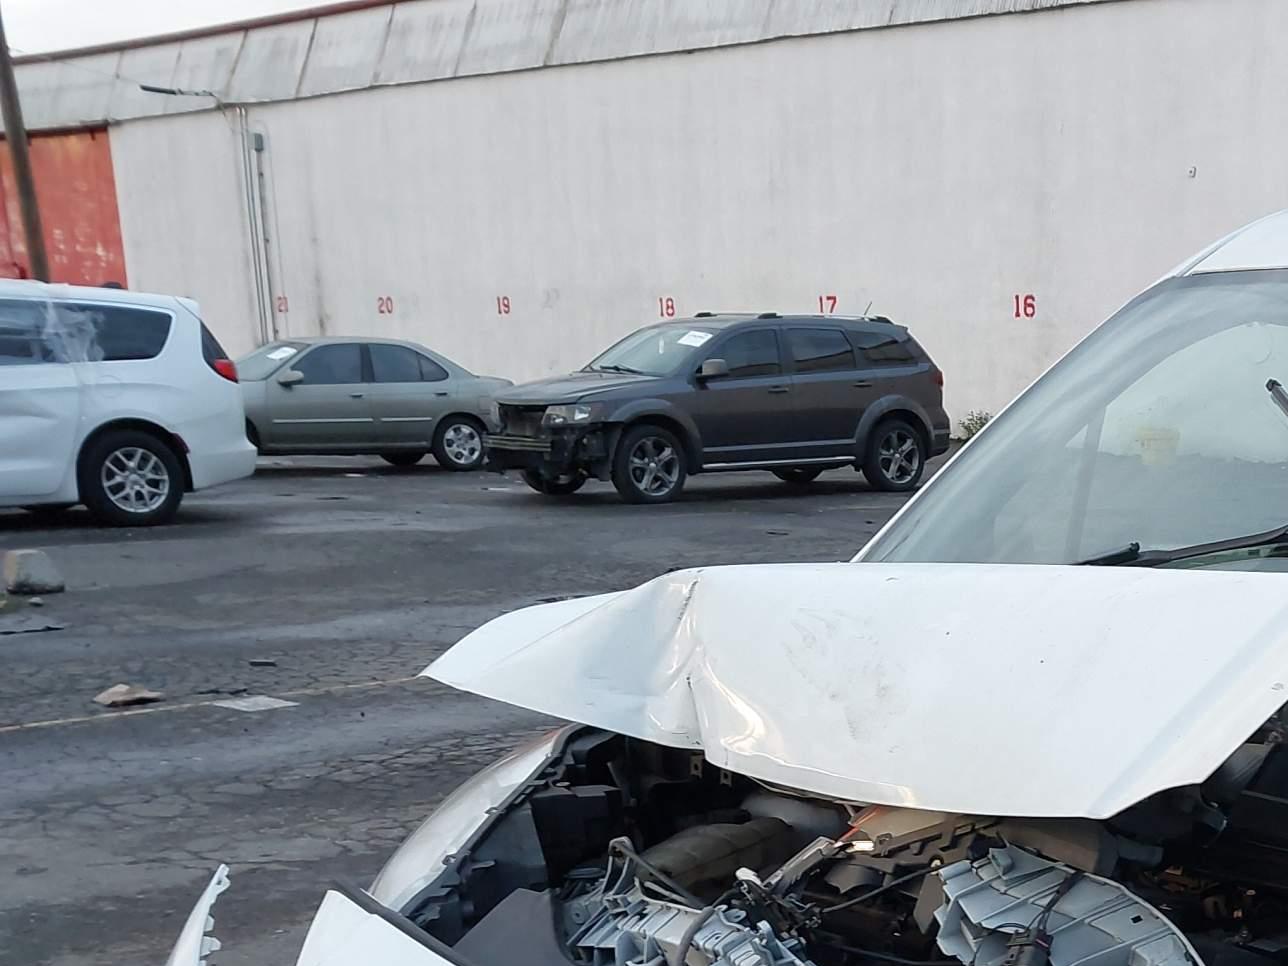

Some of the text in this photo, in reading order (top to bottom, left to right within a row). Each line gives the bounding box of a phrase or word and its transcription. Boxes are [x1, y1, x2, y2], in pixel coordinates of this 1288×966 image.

[377, 296, 393, 314] 20
[496, 296, 511, 314] 19
[658, 297, 675, 317] 18
[818, 295, 837, 314] 17
[1014, 294, 1036, 318] 16
